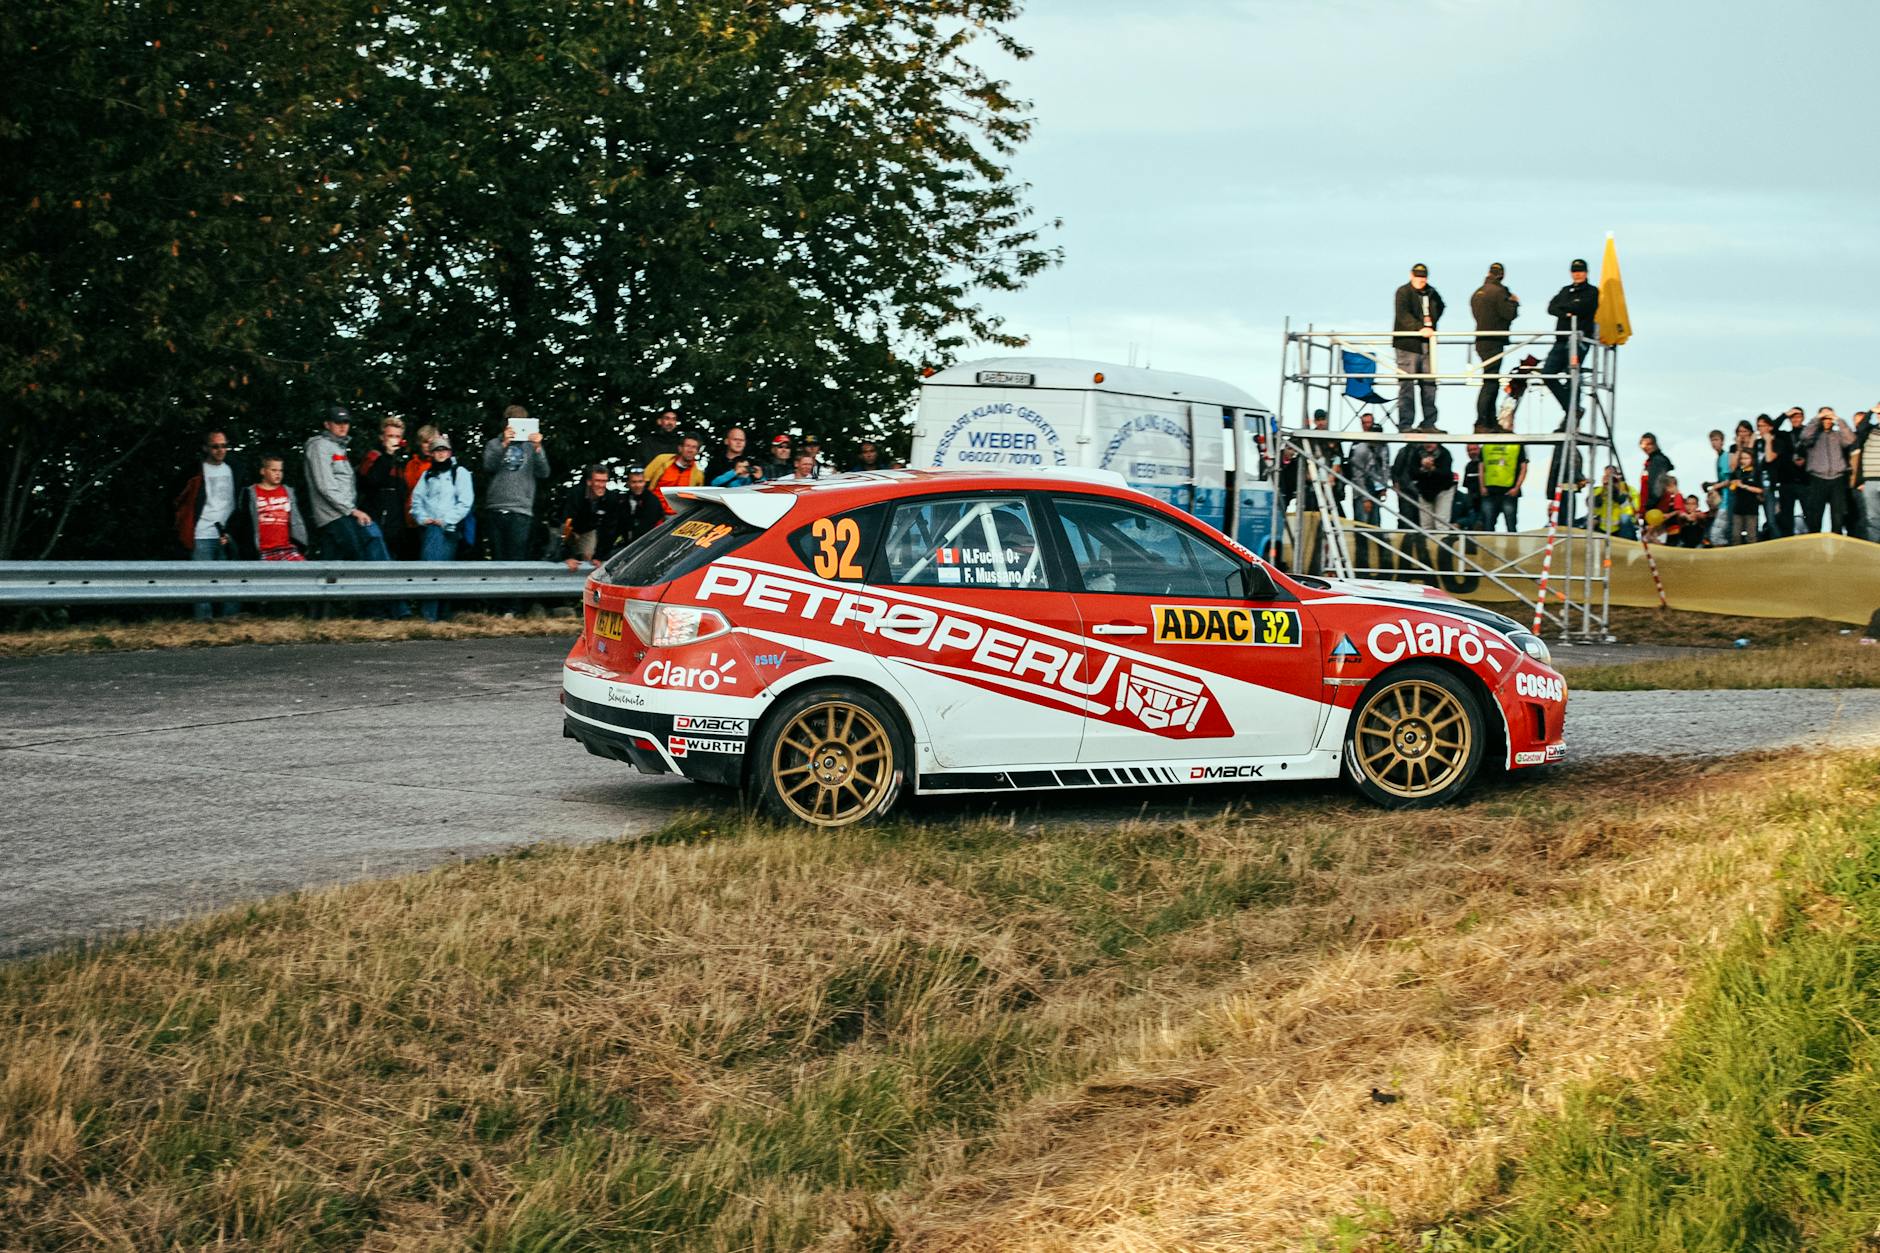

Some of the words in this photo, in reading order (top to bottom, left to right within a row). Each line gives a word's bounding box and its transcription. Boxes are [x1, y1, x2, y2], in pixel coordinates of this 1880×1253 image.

[968, 432, 1037, 449] WEBER
[695, 524, 733, 548] 32
[812, 517, 864, 579] 32
[695, 566, 1120, 696] PETROPERU
[1161, 609, 1249, 641] ADAC
[1262, 611, 1291, 644] 32
[1367, 619, 1484, 664] Claro
[643, 660, 720, 690] Claro
[1516, 672, 1562, 702] COSAS
[687, 739, 743, 753] WÜRTH
